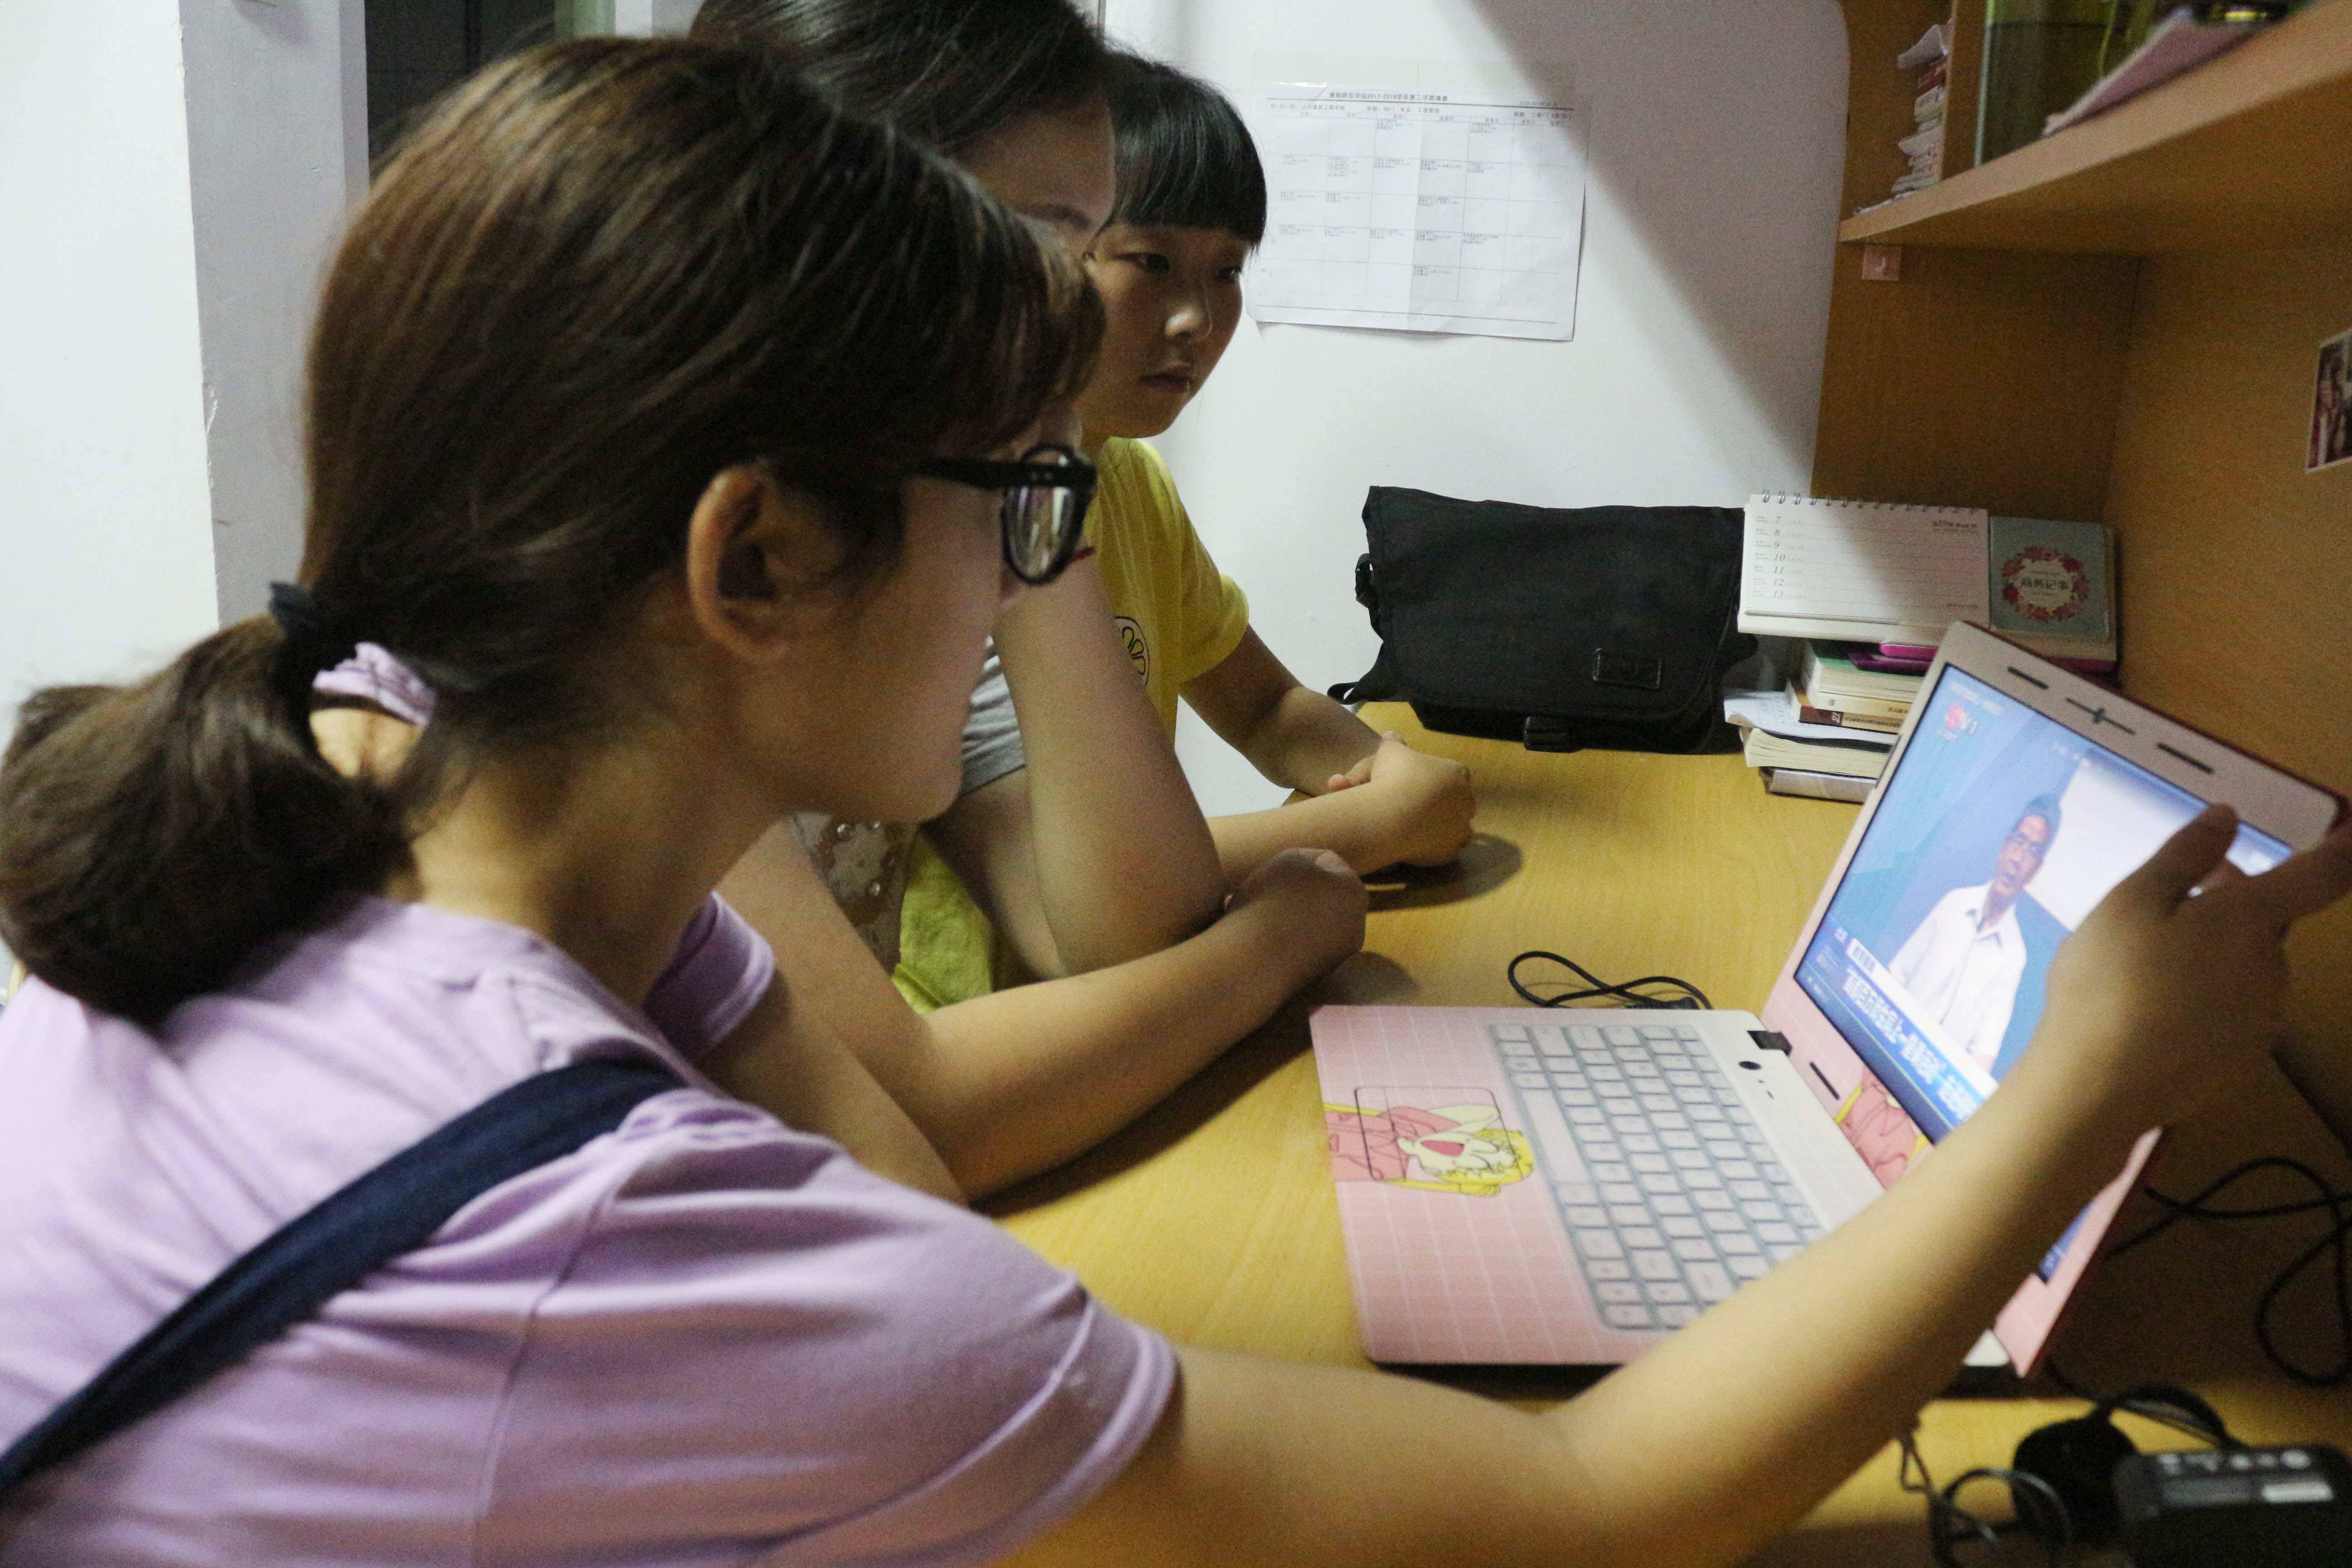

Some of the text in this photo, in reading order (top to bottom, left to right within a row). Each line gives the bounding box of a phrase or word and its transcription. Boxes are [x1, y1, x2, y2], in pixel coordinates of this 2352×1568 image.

[1774, 566, 1784, 574] 11
[1774, 578, 1784, 586] 12
[1773, 590, 1784, 599] 13
